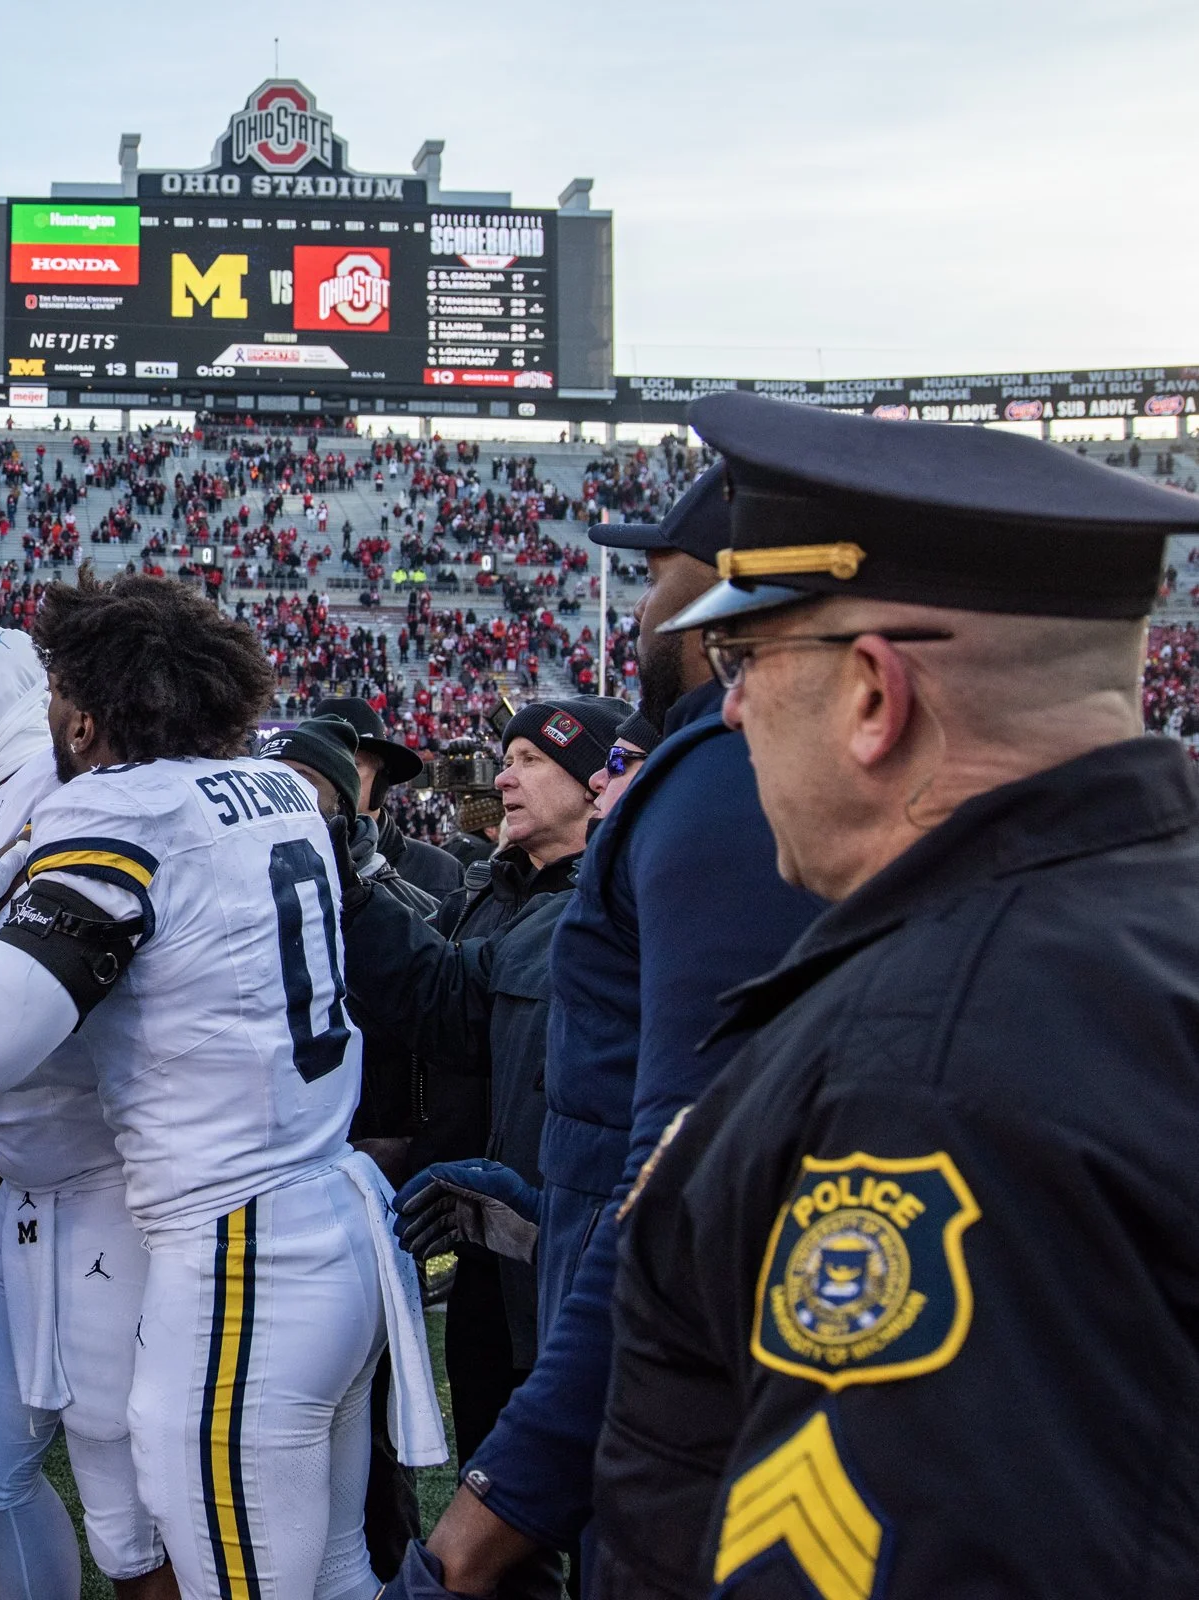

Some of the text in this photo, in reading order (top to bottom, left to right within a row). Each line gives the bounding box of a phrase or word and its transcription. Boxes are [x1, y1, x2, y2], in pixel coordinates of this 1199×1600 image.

[162, 174, 404, 199] OHIO STADIUM
[49, 212, 116, 230] Huntington
[430, 213, 481, 227] COLLEGE
[485, 215, 544, 228] FOOTBALL
[430, 226, 544, 257] SCOREBOARD
[31, 258, 121, 272] HONDA
[450, 271, 505, 282] CAROLINA
[171, 253, 249, 319] M
[270, 270, 293, 305] VS
[438, 280, 491, 290] CLEMSON
[438, 347, 499, 357] LOUISVILLE
[9, 359, 46, 376] M
[54, 364, 96, 372] MICHIGAN
[438, 356, 496, 366] KENTUCKY
[105, 362, 127, 376] 13
[144, 365, 170, 376] 4th
[196, 365, 236, 377] 0:00
[1088, 369, 1166, 383] WEBSTER
[431, 370, 455, 384] 10
[629, 377, 675, 390] BLOCH
[923, 372, 1075, 389] HUNTINGTON BANK
[691, 379, 738, 391] CRANE
[754, 381, 807, 393] PHIPPS
[1069, 382, 1144, 396] RITE RUG
[13, 391, 44, 403] meijer
[909, 389, 971, 401] NOURSE
[1002, 386, 1052, 399] PRIOR
[909, 406, 919, 421] A
[922, 405, 949, 421] SUB
[1043, 402, 1053, 418] A
[1057, 401, 1086, 417] SUB
[202, 547, 212, 564] 0
[482, 554, 492, 571] 0
[544, 727, 567, 745] POLICE
[18, 906, 49, 925] Douglas
[268, 838, 352, 1084] 0
[791, 1174, 928, 1230] POLICE
[17, 1219, 38, 1245] M
